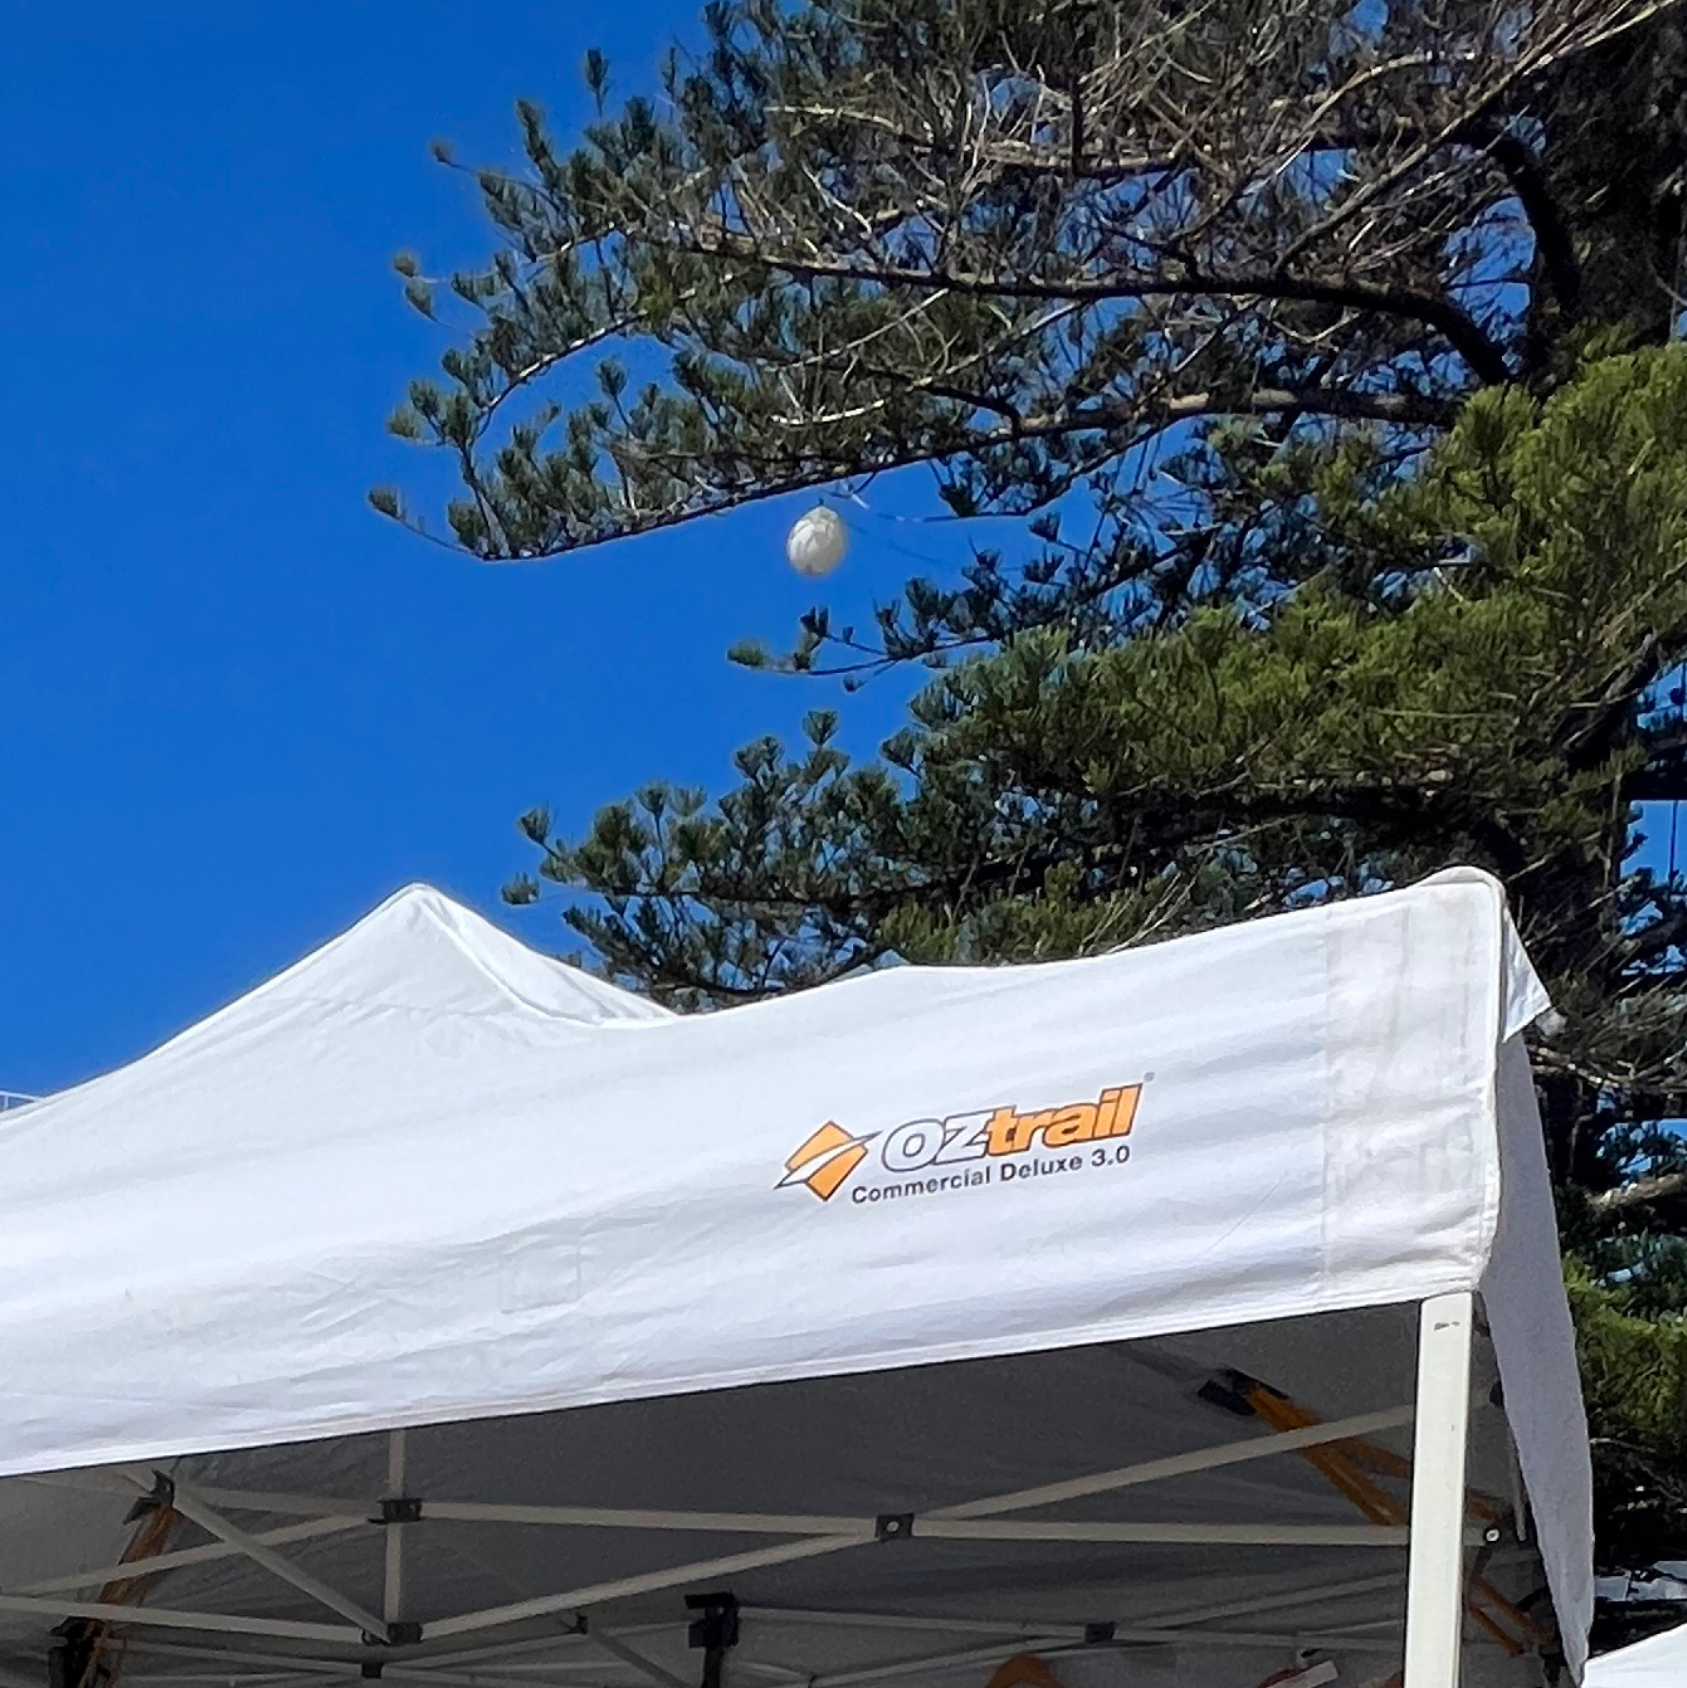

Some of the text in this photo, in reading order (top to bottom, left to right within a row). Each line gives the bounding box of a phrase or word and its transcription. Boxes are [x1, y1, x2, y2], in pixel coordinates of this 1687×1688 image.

[882, 1083, 1143, 1173] OZtrail
[852, 1144, 1131, 1204] Commercial Deluxe 3.0
